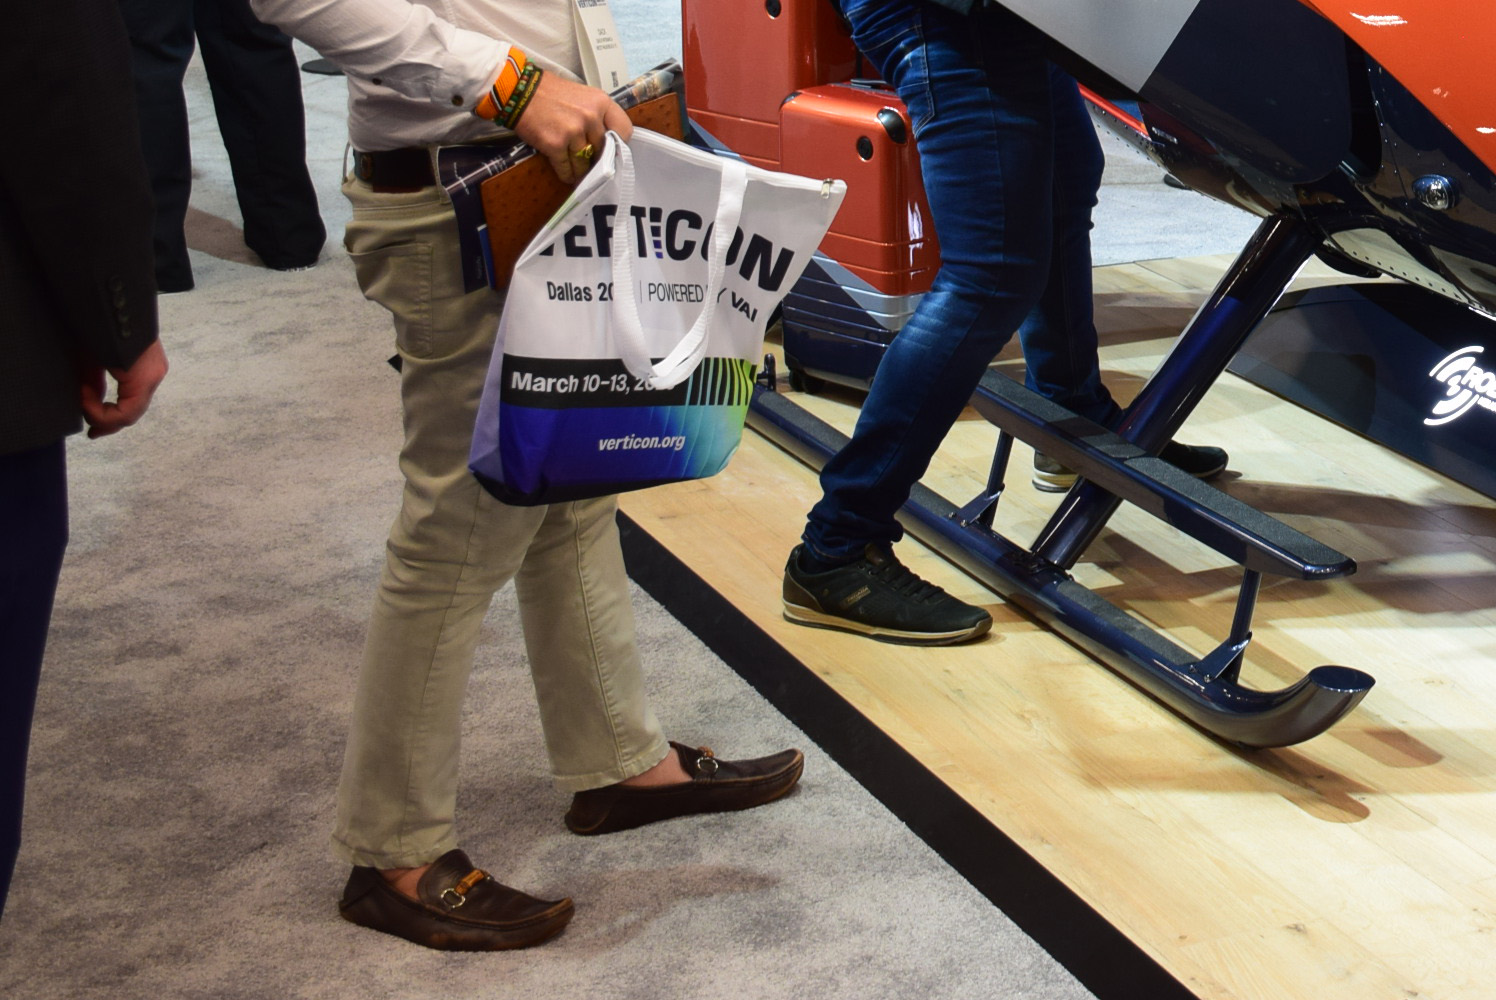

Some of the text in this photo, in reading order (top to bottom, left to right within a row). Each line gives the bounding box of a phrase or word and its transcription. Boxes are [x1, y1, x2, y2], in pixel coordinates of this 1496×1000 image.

[547, 281, 593, 302] Dallas
[649, 283, 704, 303] POWERED
[731, 291, 758, 323] VAI
[511, 371, 579, 394] March
[599, 434, 687, 452] verticon.org
